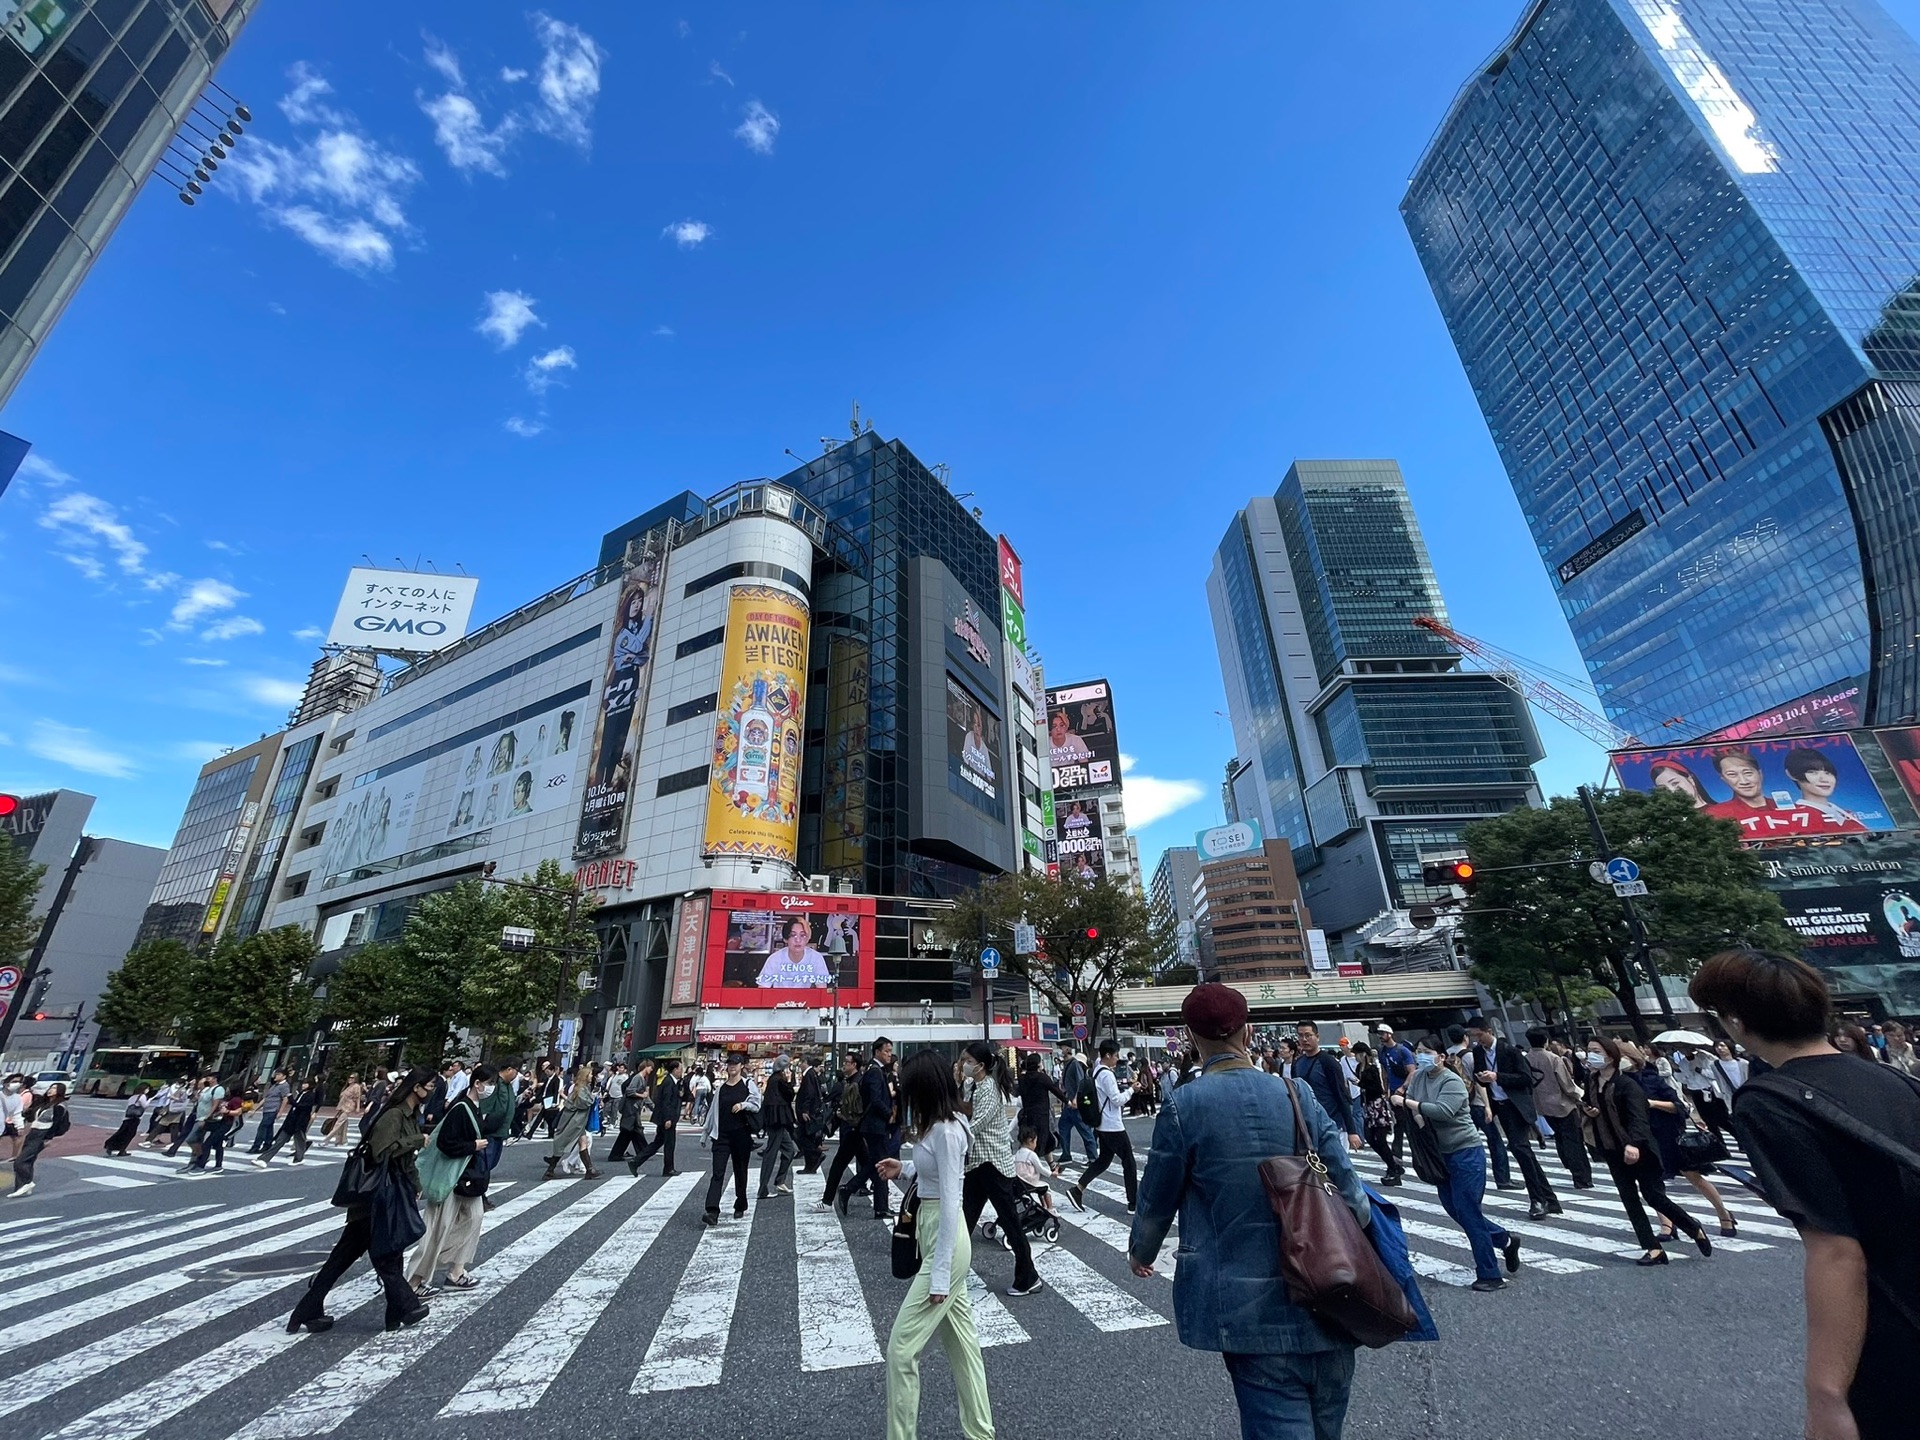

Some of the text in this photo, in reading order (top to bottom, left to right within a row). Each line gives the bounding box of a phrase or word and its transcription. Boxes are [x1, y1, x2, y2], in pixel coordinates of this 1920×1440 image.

[1572, 541, 1603, 565] SHIBUYA
[1575, 519, 1643, 572] SCRAMBLE SQUARE
[366, 583, 457, 600] すべての人に
[360, 598, 452, 614] インターネット
[353, 615, 447, 636] GMO
[745, 623, 804, 653] AWAKEN
[745, 644, 804, 674] THE FIESTA
[603, 677, 634, 700] トク
[1059, 693, 1073, 701] ゼノ
[1812, 686, 1860, 711] Release
[1050, 750, 1095, 762] ールするだけ!
[1060, 774, 1088, 788] GET!
[587, 782, 607, 799] 10.16
[0, 807, 49, 836] ARA
[1740, 812, 1809, 831] イトク
[590, 827, 618, 842] フジテレビ
[1057, 838, 1085, 855] 1000
[1790, 862, 1849, 877] shibuya
[1850, 859, 1903, 873] station
[1784, 912, 1871, 927] THE GREATEST
[916, 943, 943, 951] COFFEE
[1826, 936, 1846, 946] ON
[1849, 935, 1878, 946] SALE
[677, 914, 699, 1000] 天津甘栗
[780, 963, 814, 973] XENOを
[1259, 979, 1367, 999] 渋谷駅
[659, 1024, 691, 1037] 天津甘栗
[702, 1034, 736, 1042] SANZENRI
